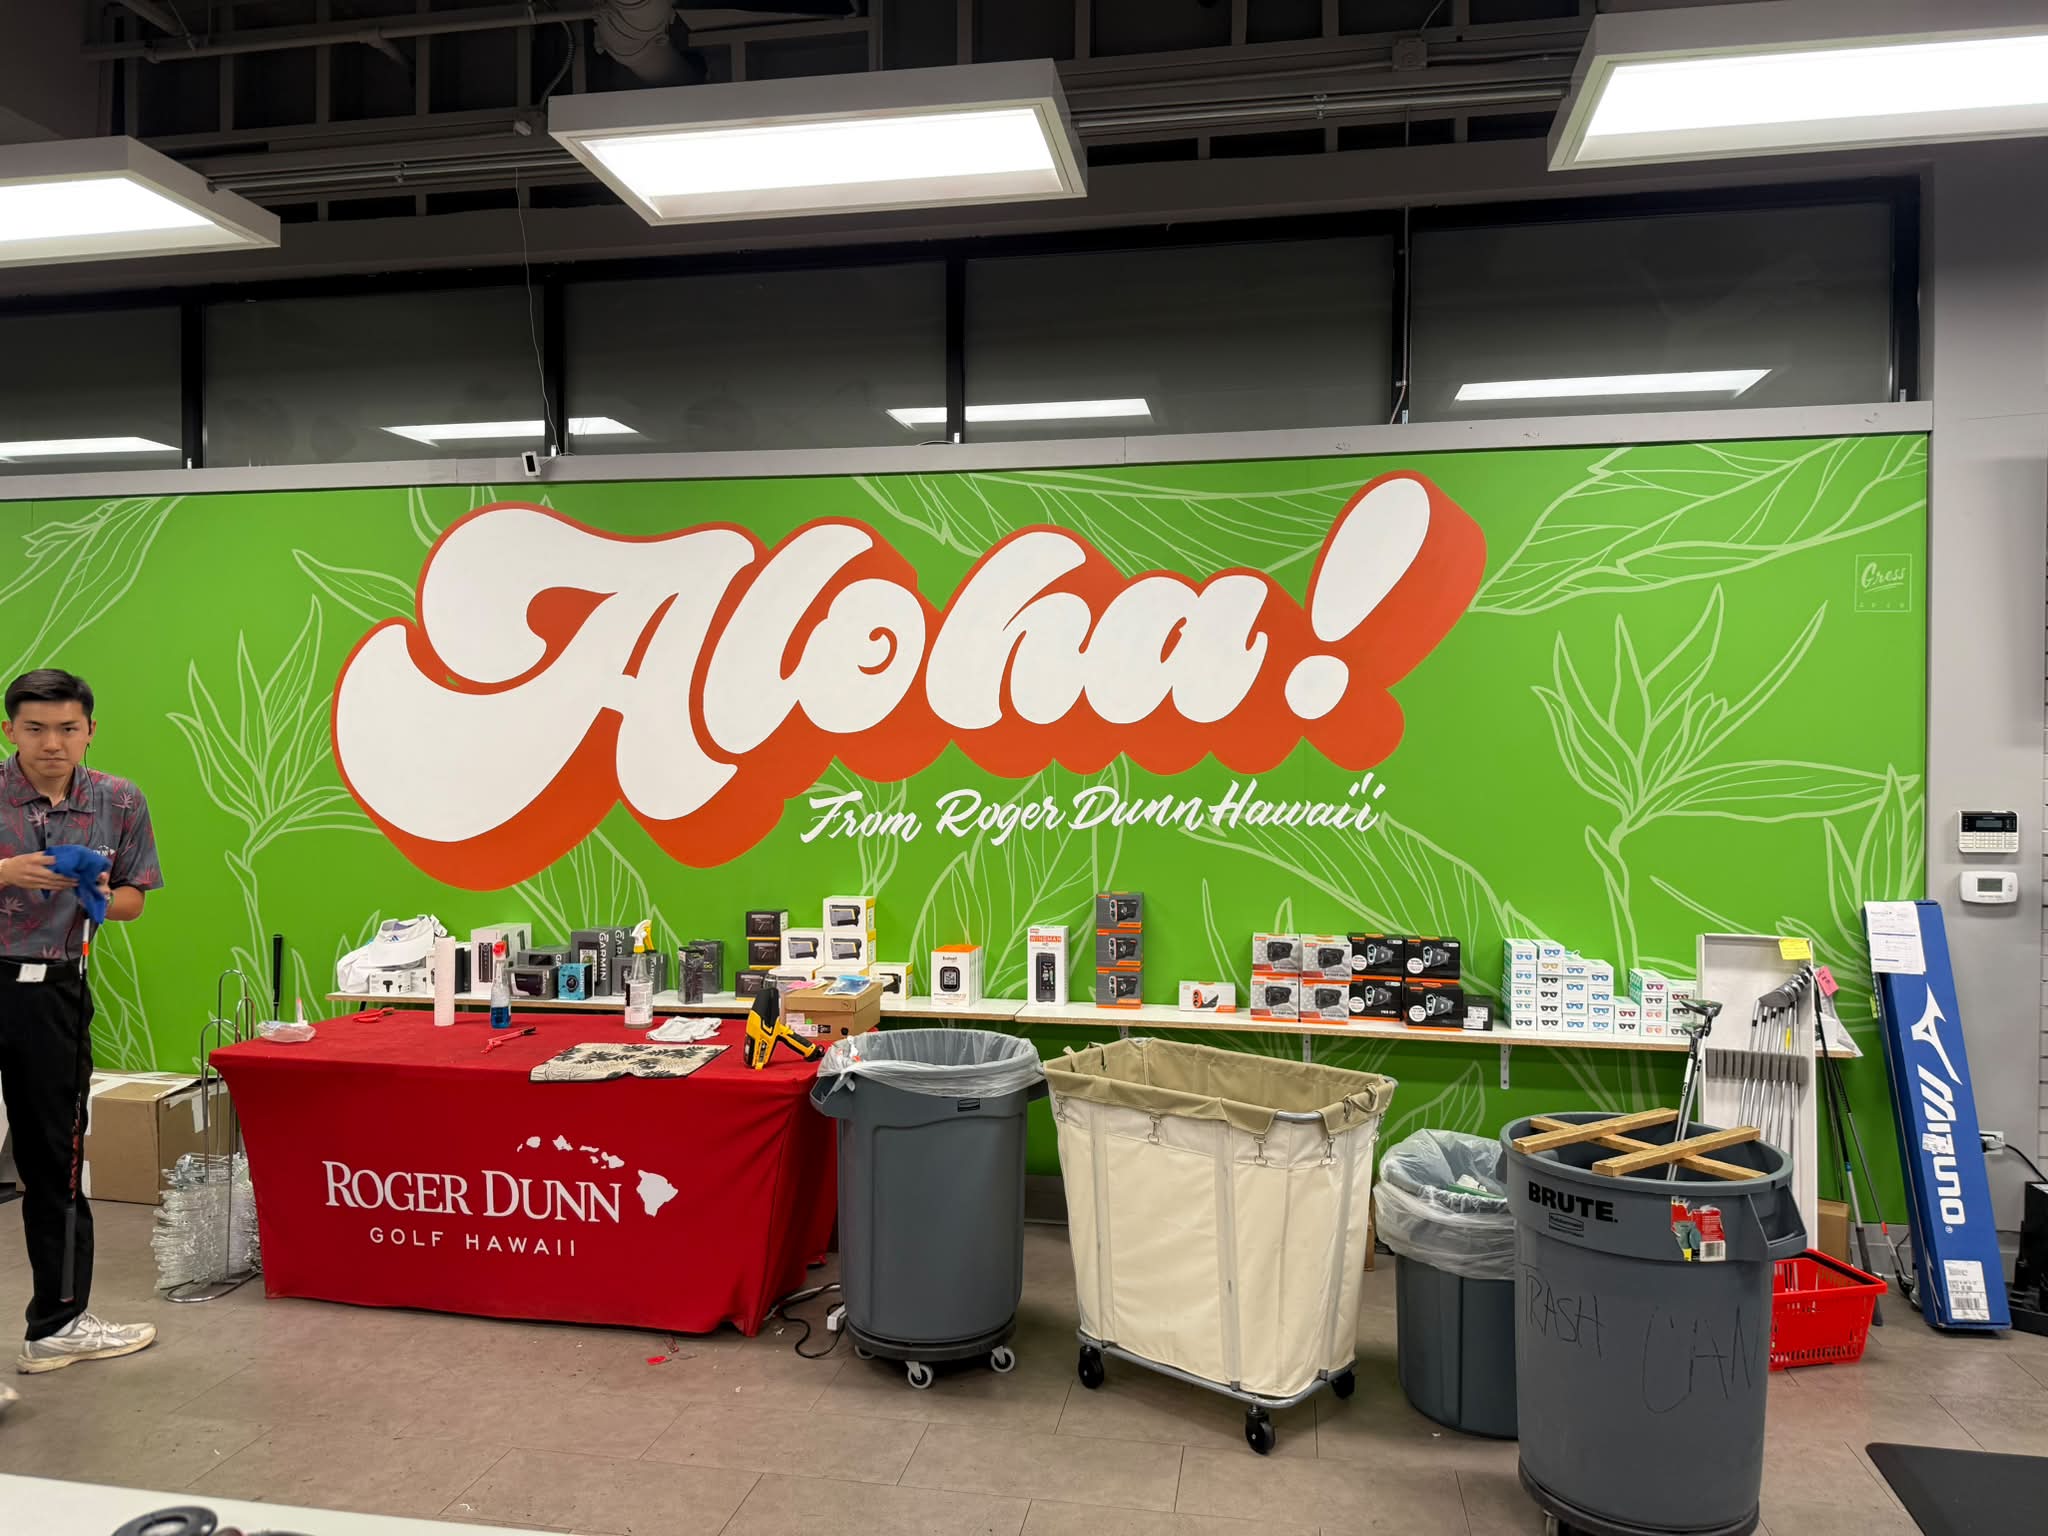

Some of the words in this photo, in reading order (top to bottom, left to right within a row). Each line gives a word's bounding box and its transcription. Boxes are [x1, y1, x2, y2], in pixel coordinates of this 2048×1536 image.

[335, 476, 1431, 845] Aloha!
[800, 791, 922, 843] From
[936, 788, 1071, 846] Roger
[1072, 786, 1204, 831] Dunn
[598, 932, 608, 981] GARMIN
[615, 930, 623, 955] GAR
[323, 1161, 471, 1215] ROGER
[483, 1170, 622, 1224] DUNN
[370, 1227, 443, 1247] GOLF
[465, 1233, 575, 1256] HAWAII
